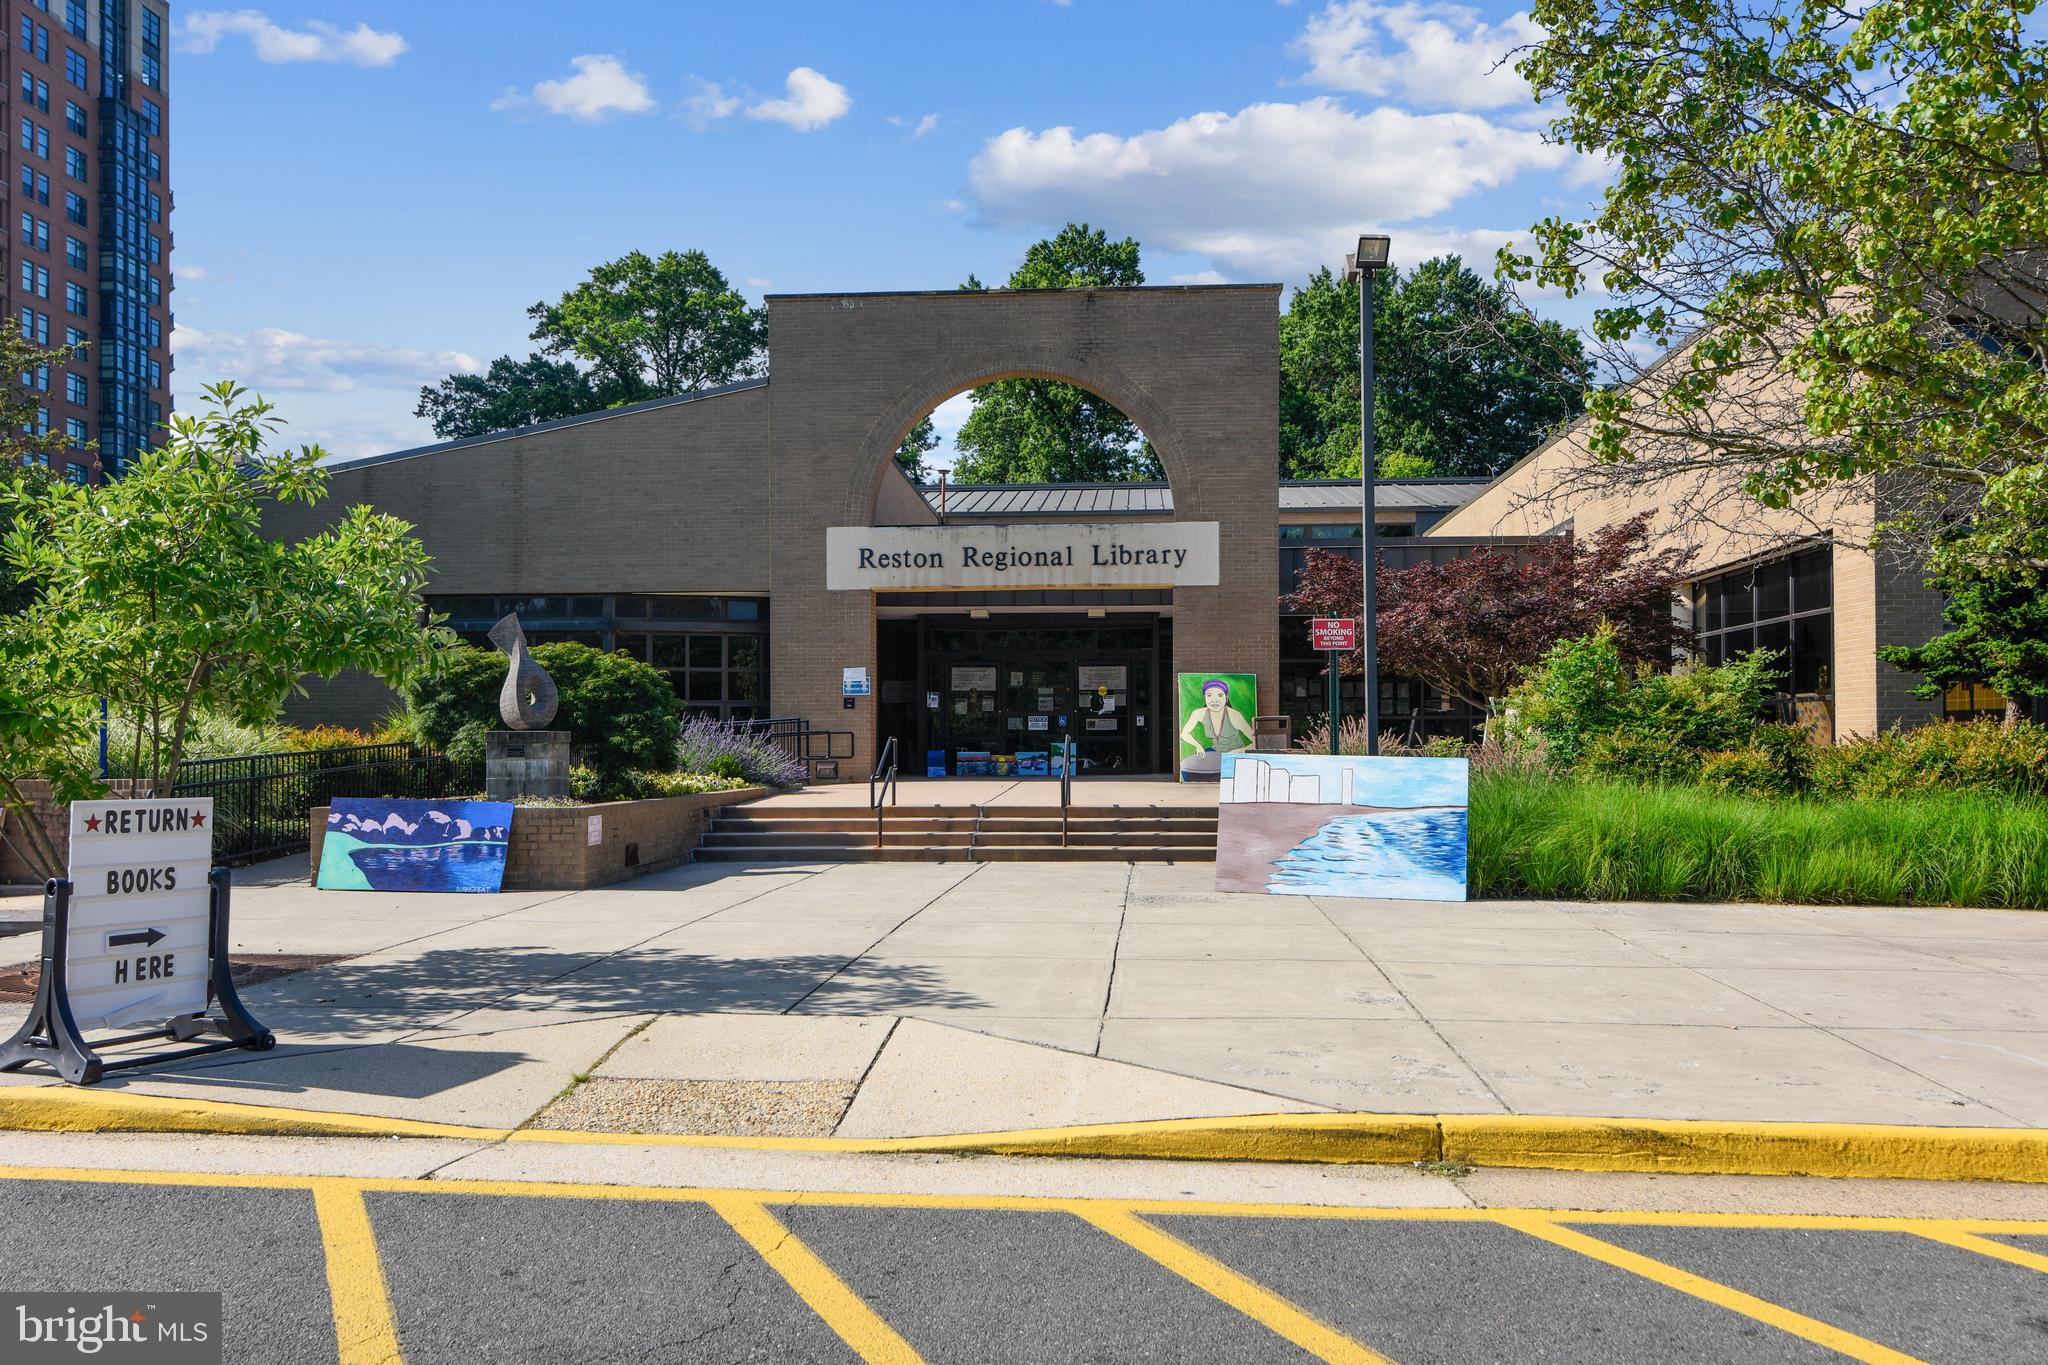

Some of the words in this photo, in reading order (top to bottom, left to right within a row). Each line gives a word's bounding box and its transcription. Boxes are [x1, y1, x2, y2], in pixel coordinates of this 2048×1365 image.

[858, 548, 944, 569] Reston
[962, 546, 1073, 571] Regional
[1091, 544, 1187, 568] Library
[1327, 621, 1340, 629] NO
[105, 808, 189, 834] RETURN
[107, 867, 176, 895] BOOKS
[115, 954, 175, 985] HERE
